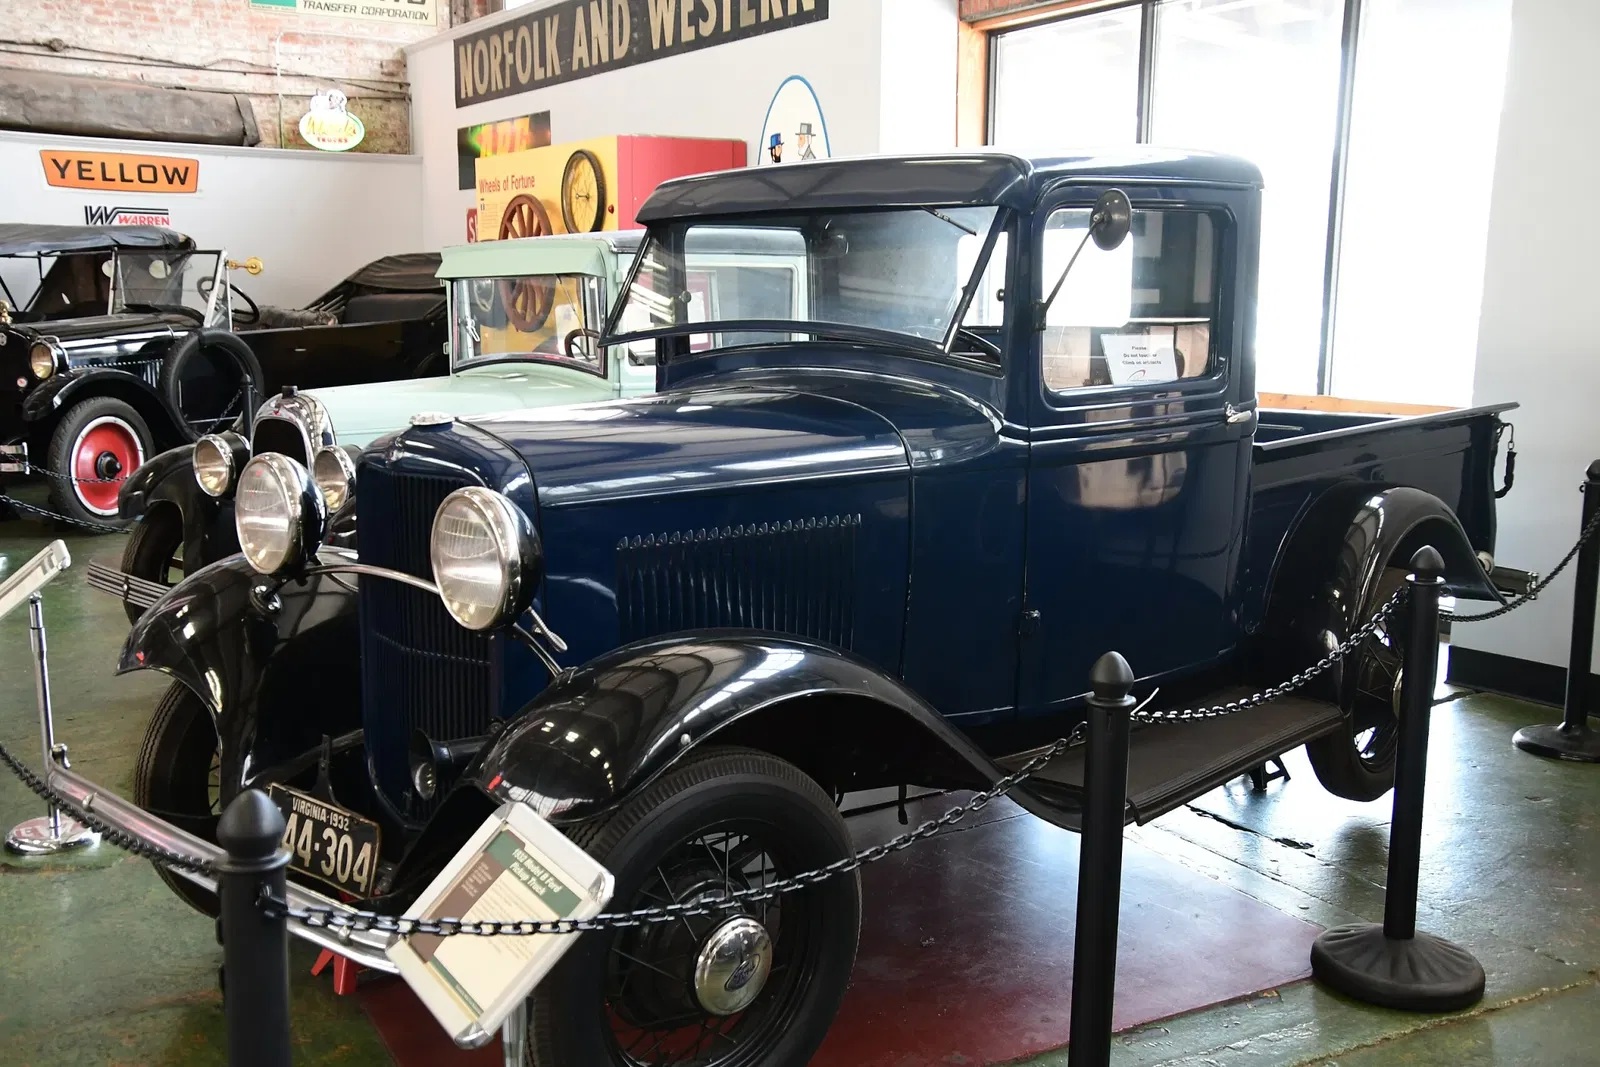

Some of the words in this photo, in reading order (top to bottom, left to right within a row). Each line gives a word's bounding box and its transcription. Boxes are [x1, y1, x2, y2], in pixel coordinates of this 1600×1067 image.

[303, 1, 357, 14] TRANSFER
[361, 5, 429, 20] CORPORATION
[458, 14, 562, 99] NORFOLK
[571, 0, 631, 71] AND
[51, 158, 190, 186] YELLOW
[479, 178, 501, 194] Wheels
[503, 176, 509, 191] of
[511, 174, 535, 190] Fortune
[118, 214, 170, 226] WARREN
[510, 861, 530, 881] Pickup
[527, 876, 546, 896] Truck
[523, 858, 545, 878] Model
[545, 876, 564, 893] Ford
